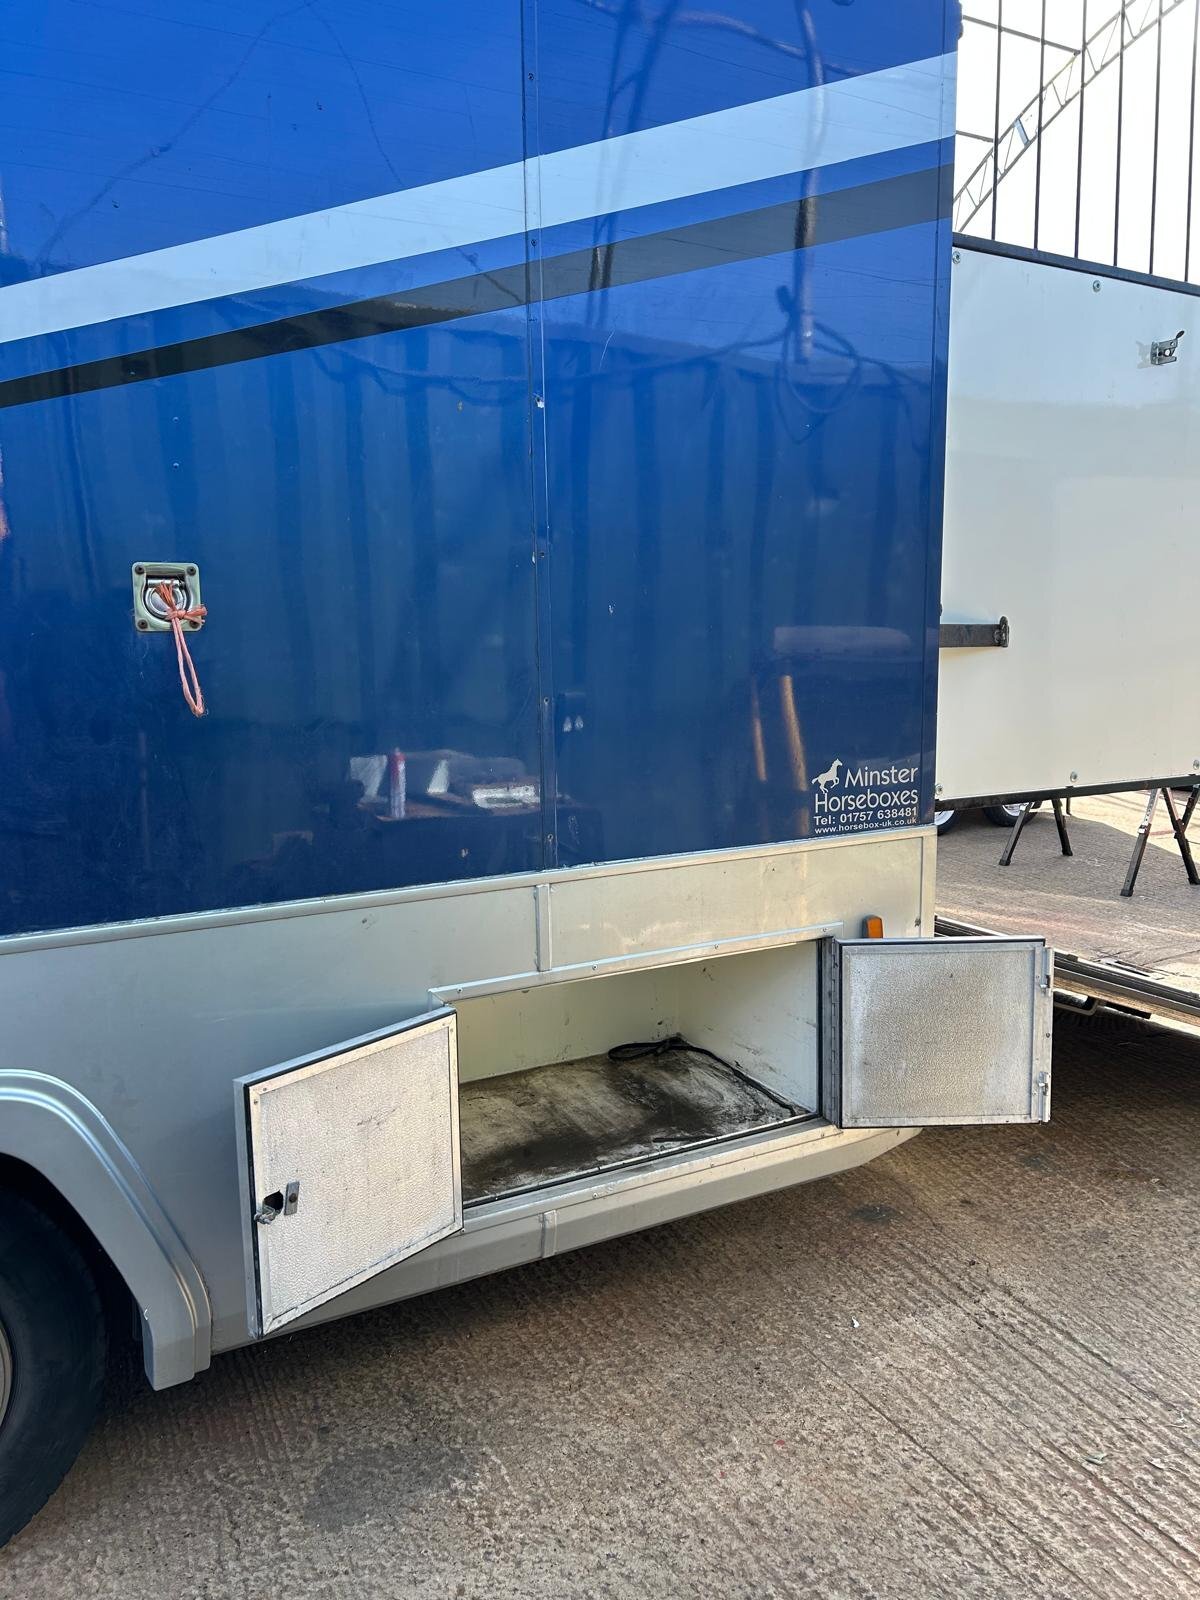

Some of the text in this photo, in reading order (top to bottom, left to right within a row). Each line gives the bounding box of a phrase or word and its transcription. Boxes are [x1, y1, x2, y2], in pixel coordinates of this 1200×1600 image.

[845, 766, 918, 788] Minster
[815, 789, 918, 813] Horseboxes
[813, 807, 917, 826] Tel: 01757 638481
[814, 819, 917, 834] www.horsebox-uk.co.uk
